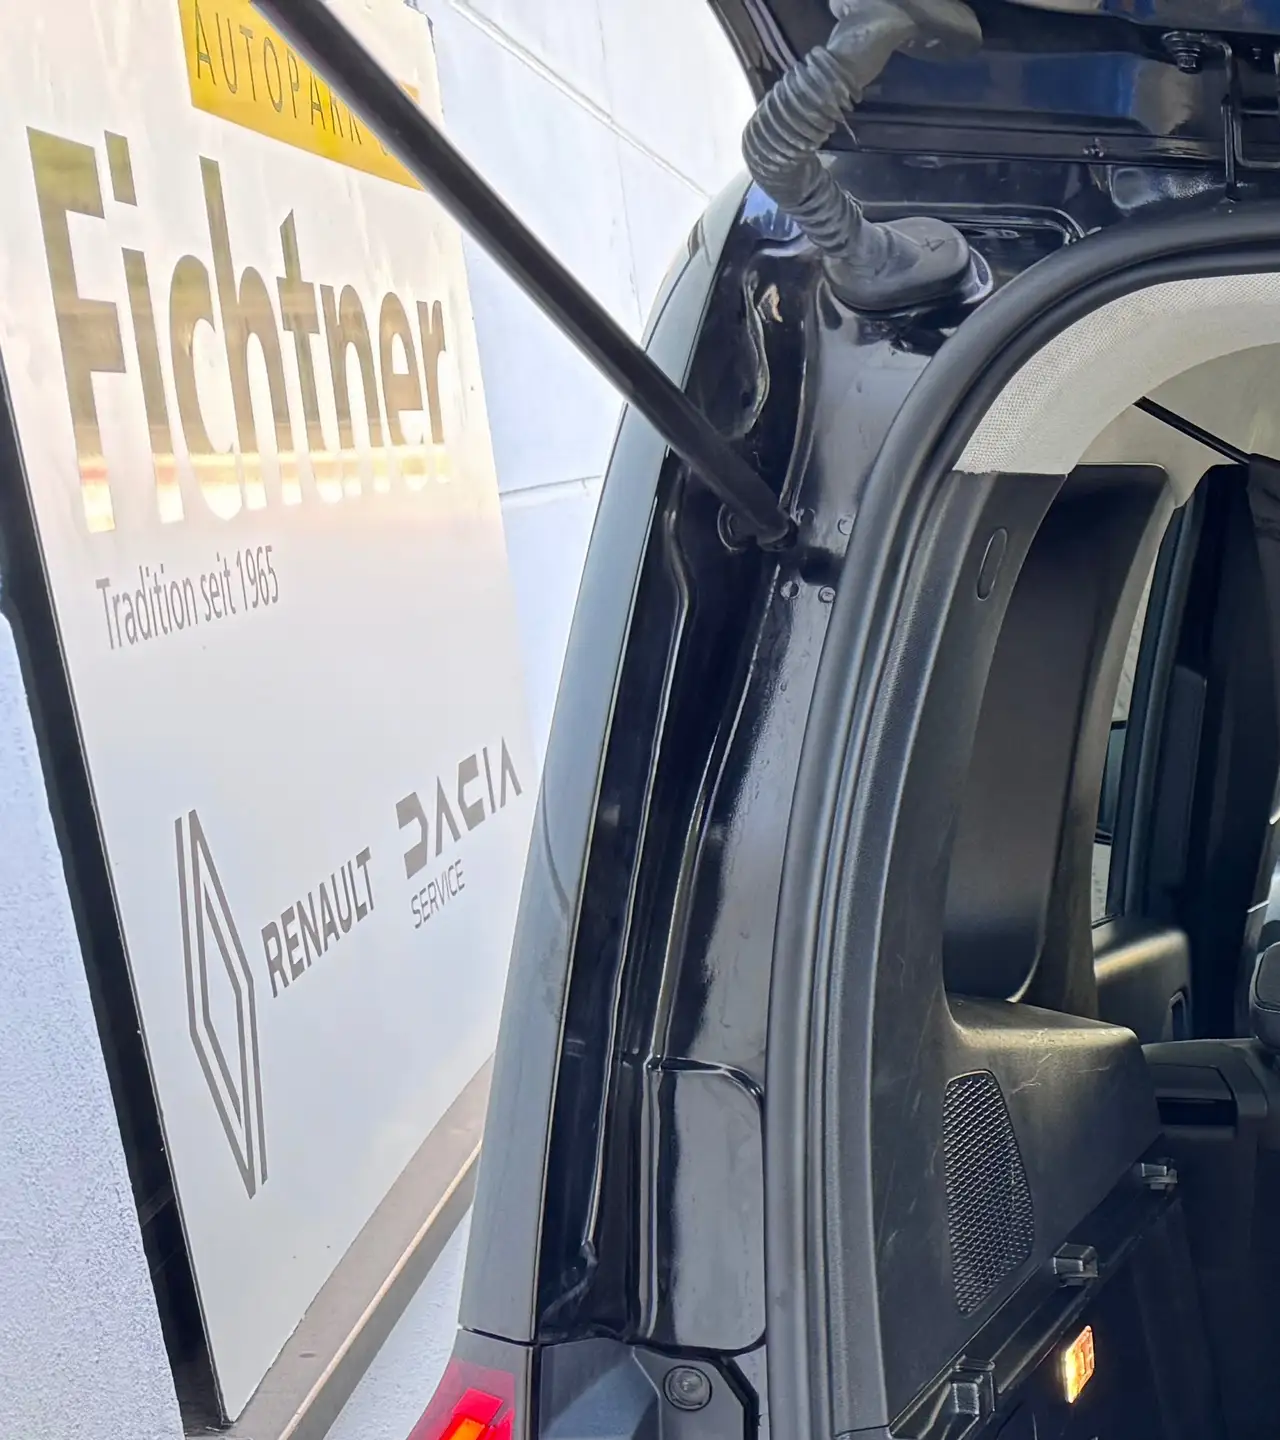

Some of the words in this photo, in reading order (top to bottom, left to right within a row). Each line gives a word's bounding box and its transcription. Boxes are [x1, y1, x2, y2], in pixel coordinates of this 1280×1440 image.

[26, 126, 451, 533] Fichtner
[95, 563, 198, 650] Tradition
[200, 551, 237, 622] seit
[236, 545, 279, 611] 1965
[396, 735, 522, 880] DACIA
[261, 846, 374, 998] RENAULT
[411, 859, 465, 929] SERVICE
